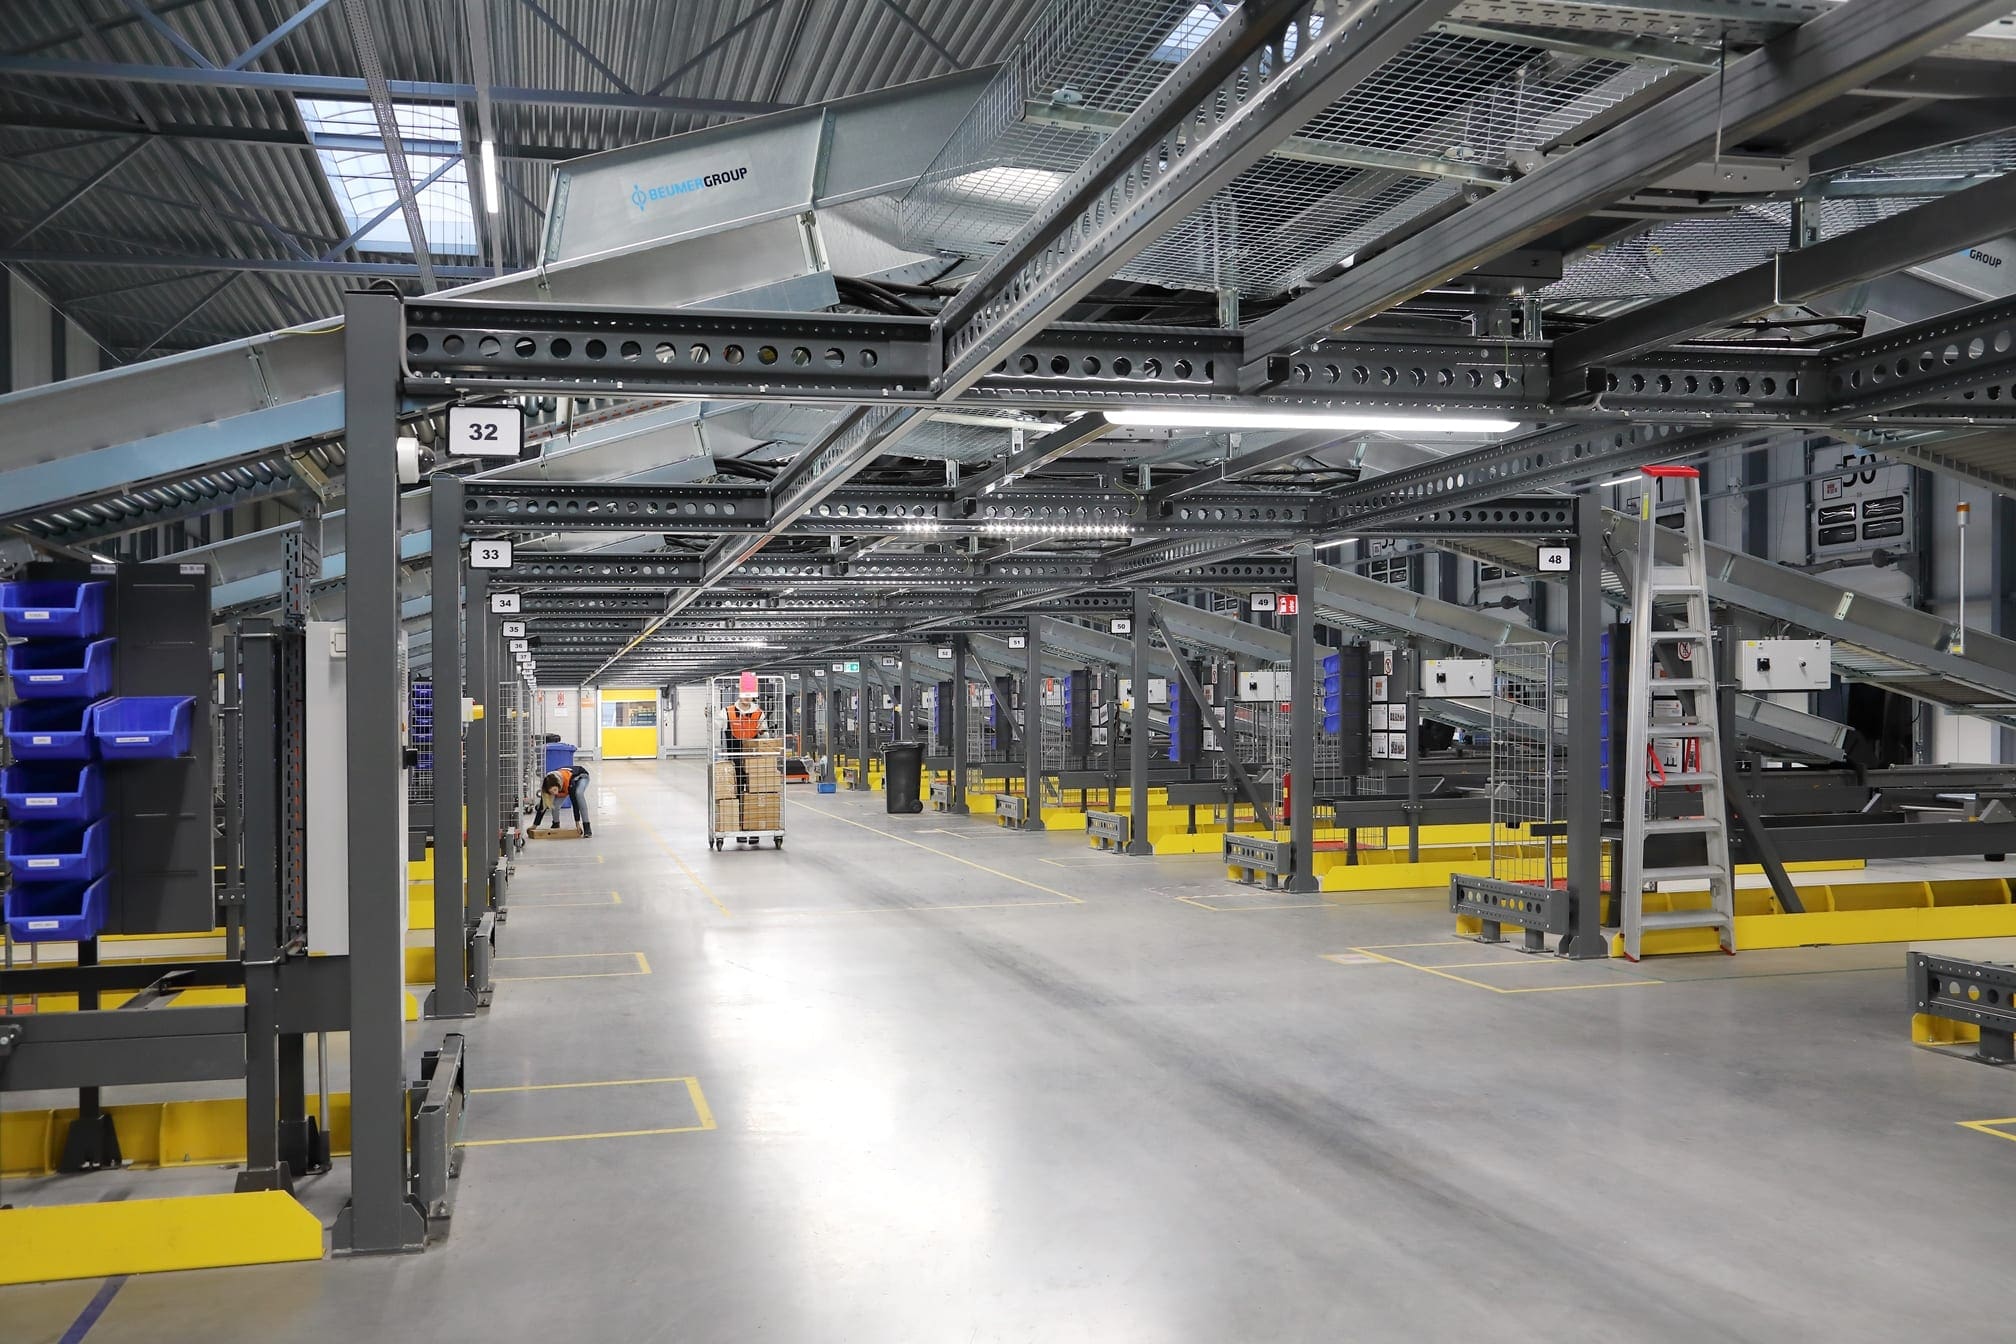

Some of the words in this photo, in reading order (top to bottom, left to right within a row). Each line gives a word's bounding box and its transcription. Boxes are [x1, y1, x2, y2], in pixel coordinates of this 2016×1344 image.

[649, 167, 748, 201] BEUMERGROUP
[468, 423, 498, 441] 32
[482, 549, 500, 560] 33
[1548, 554, 1562, 565] 48
[499, 600, 511, 608] 34
